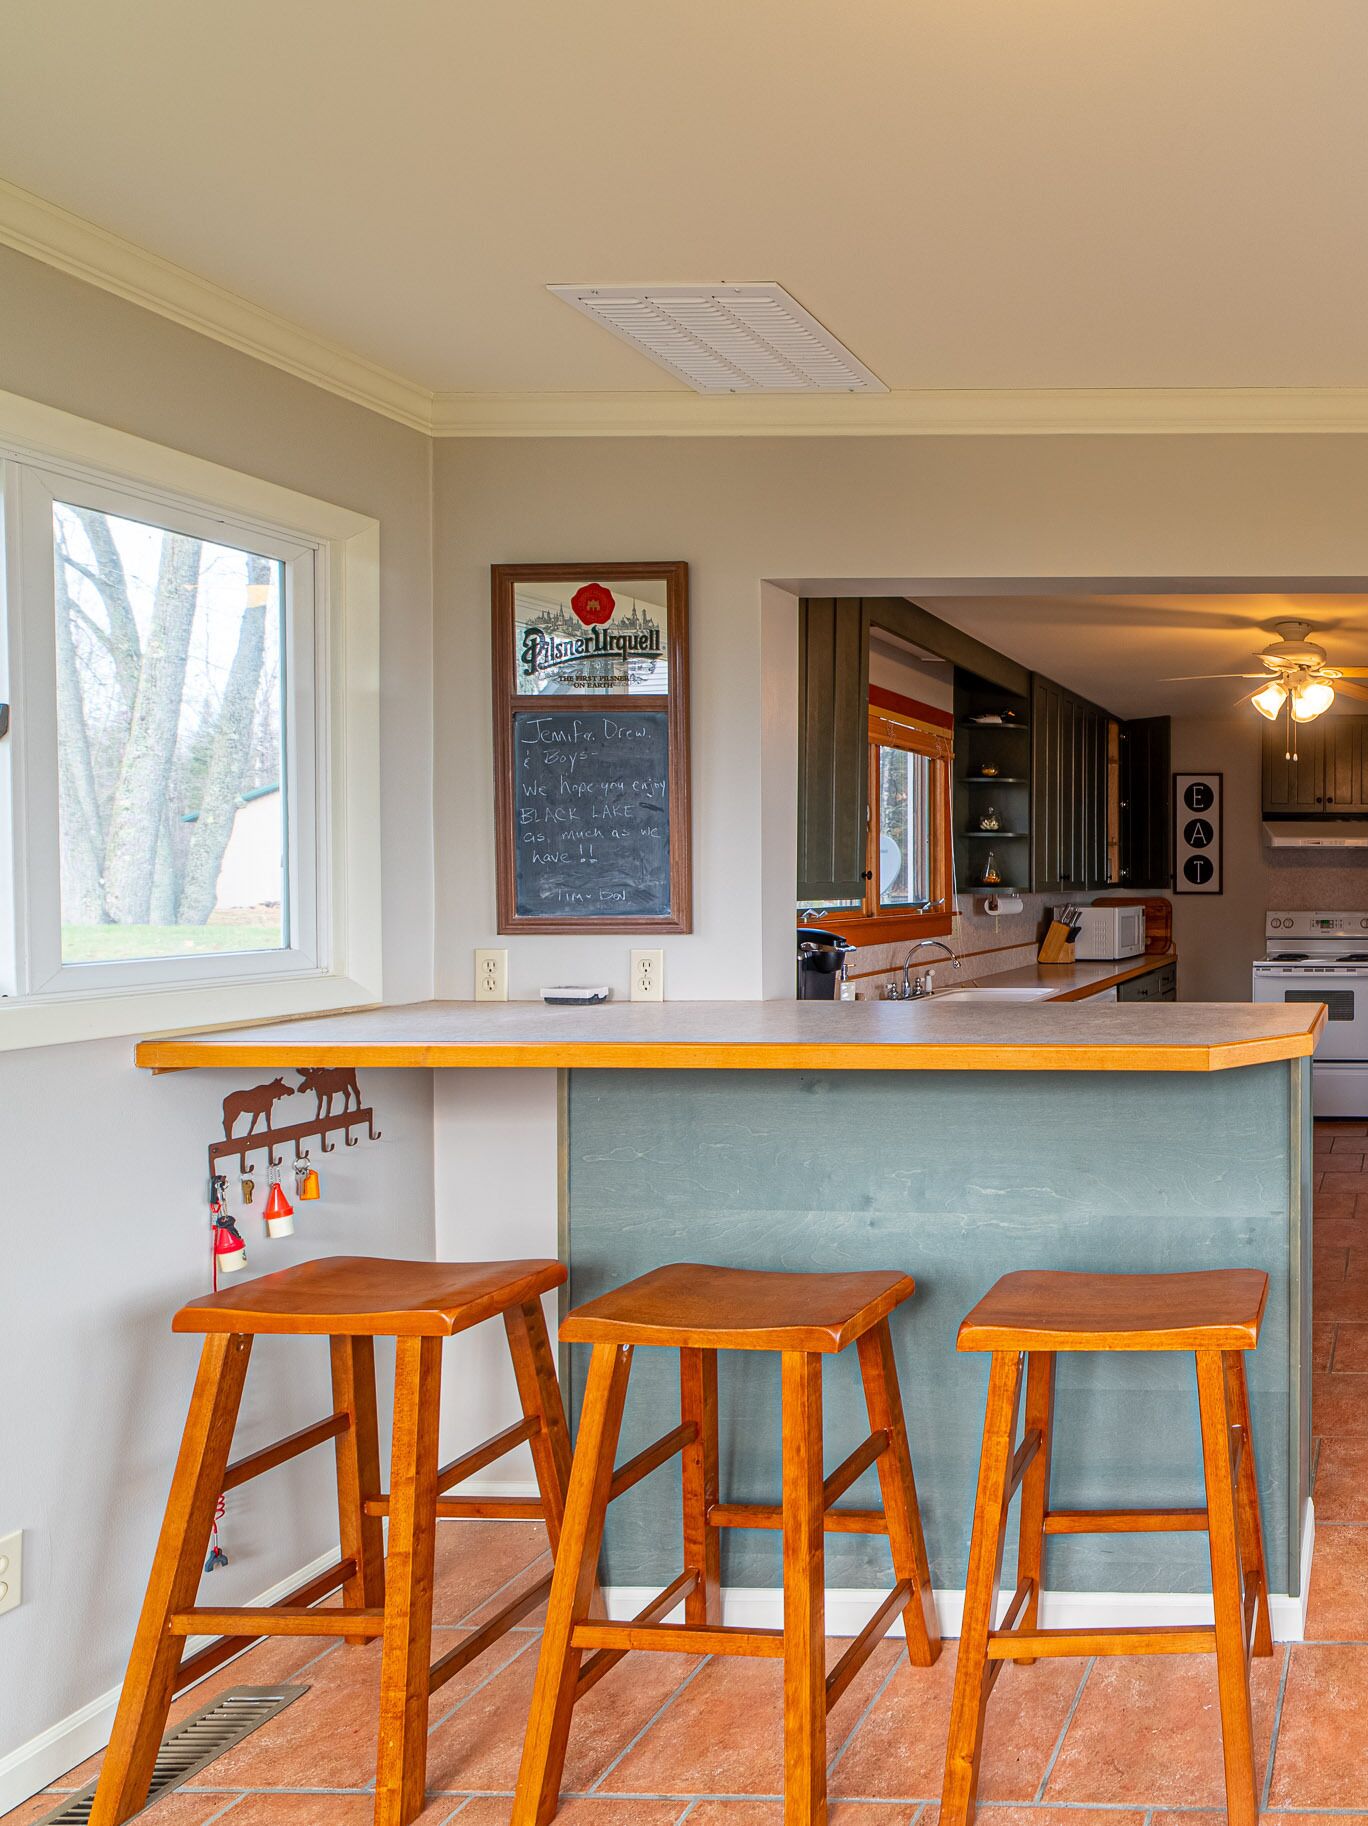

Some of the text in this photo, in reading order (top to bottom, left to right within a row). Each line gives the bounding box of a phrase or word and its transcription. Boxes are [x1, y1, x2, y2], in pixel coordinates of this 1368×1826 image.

[521, 625, 660, 676] Pilsner Urquell
[522, 775, 666, 797] We hope you enjoy
[520, 804, 635, 824] BLACK LAKE
[562, 828, 604, 841] much
[612, 830, 630, 839] as
[640, 827, 661, 838] we
[532, 850, 572, 864] have
